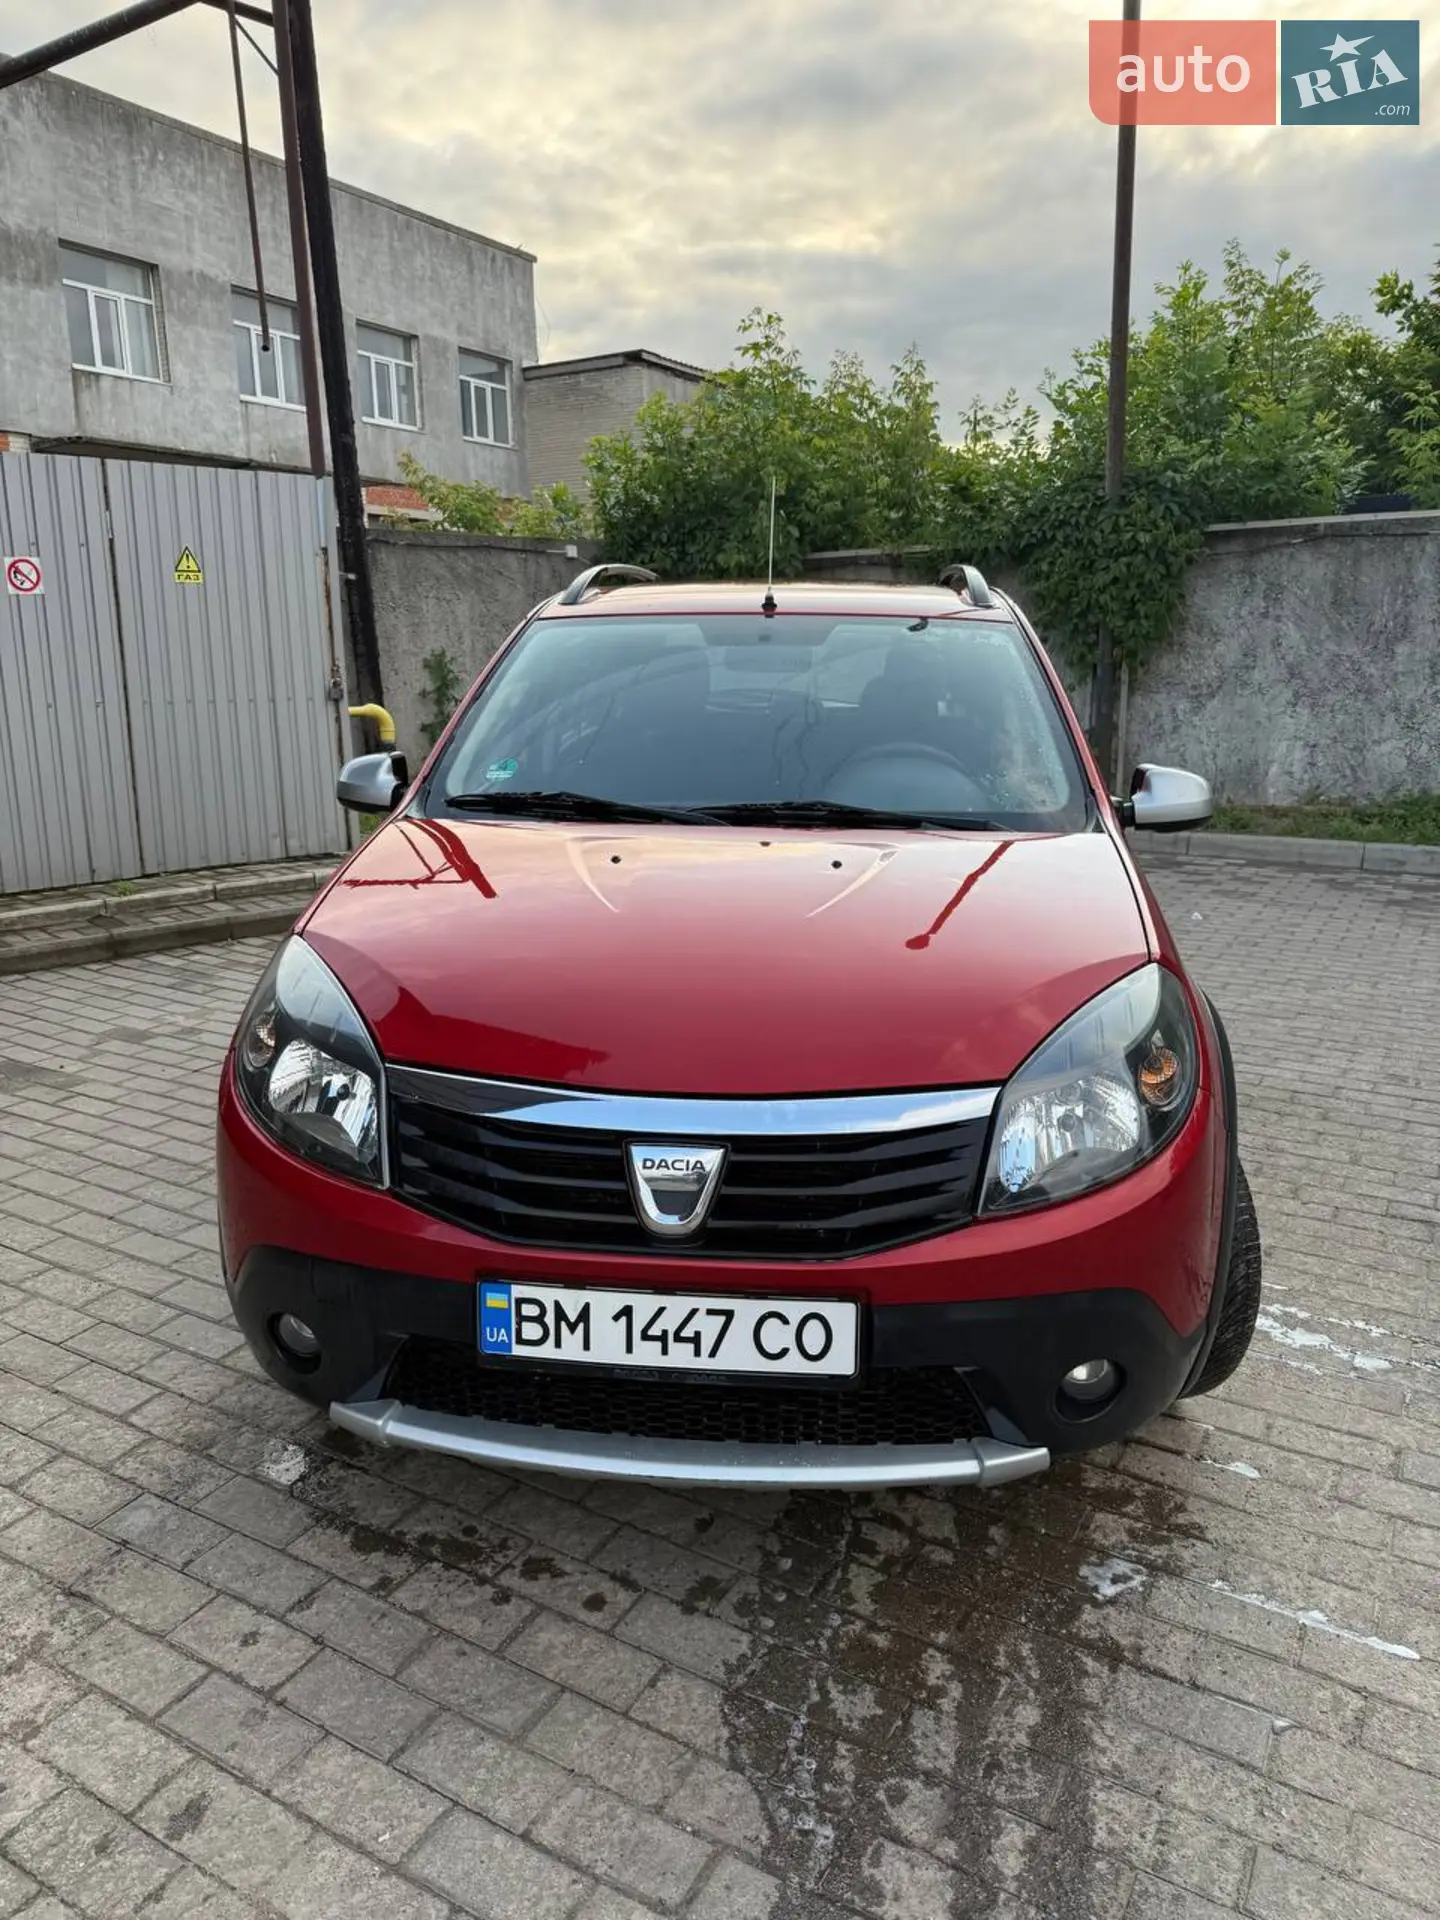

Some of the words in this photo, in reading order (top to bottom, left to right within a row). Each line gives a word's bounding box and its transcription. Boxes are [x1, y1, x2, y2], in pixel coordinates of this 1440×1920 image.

[642, 1158, 706, 1172] DACIA
[485, 1327, 509, 1344] UA
[514, 1297, 591, 1351] BM
[611, 1304, 735, 1359] 1447
[752, 1310, 834, 1363] CO
